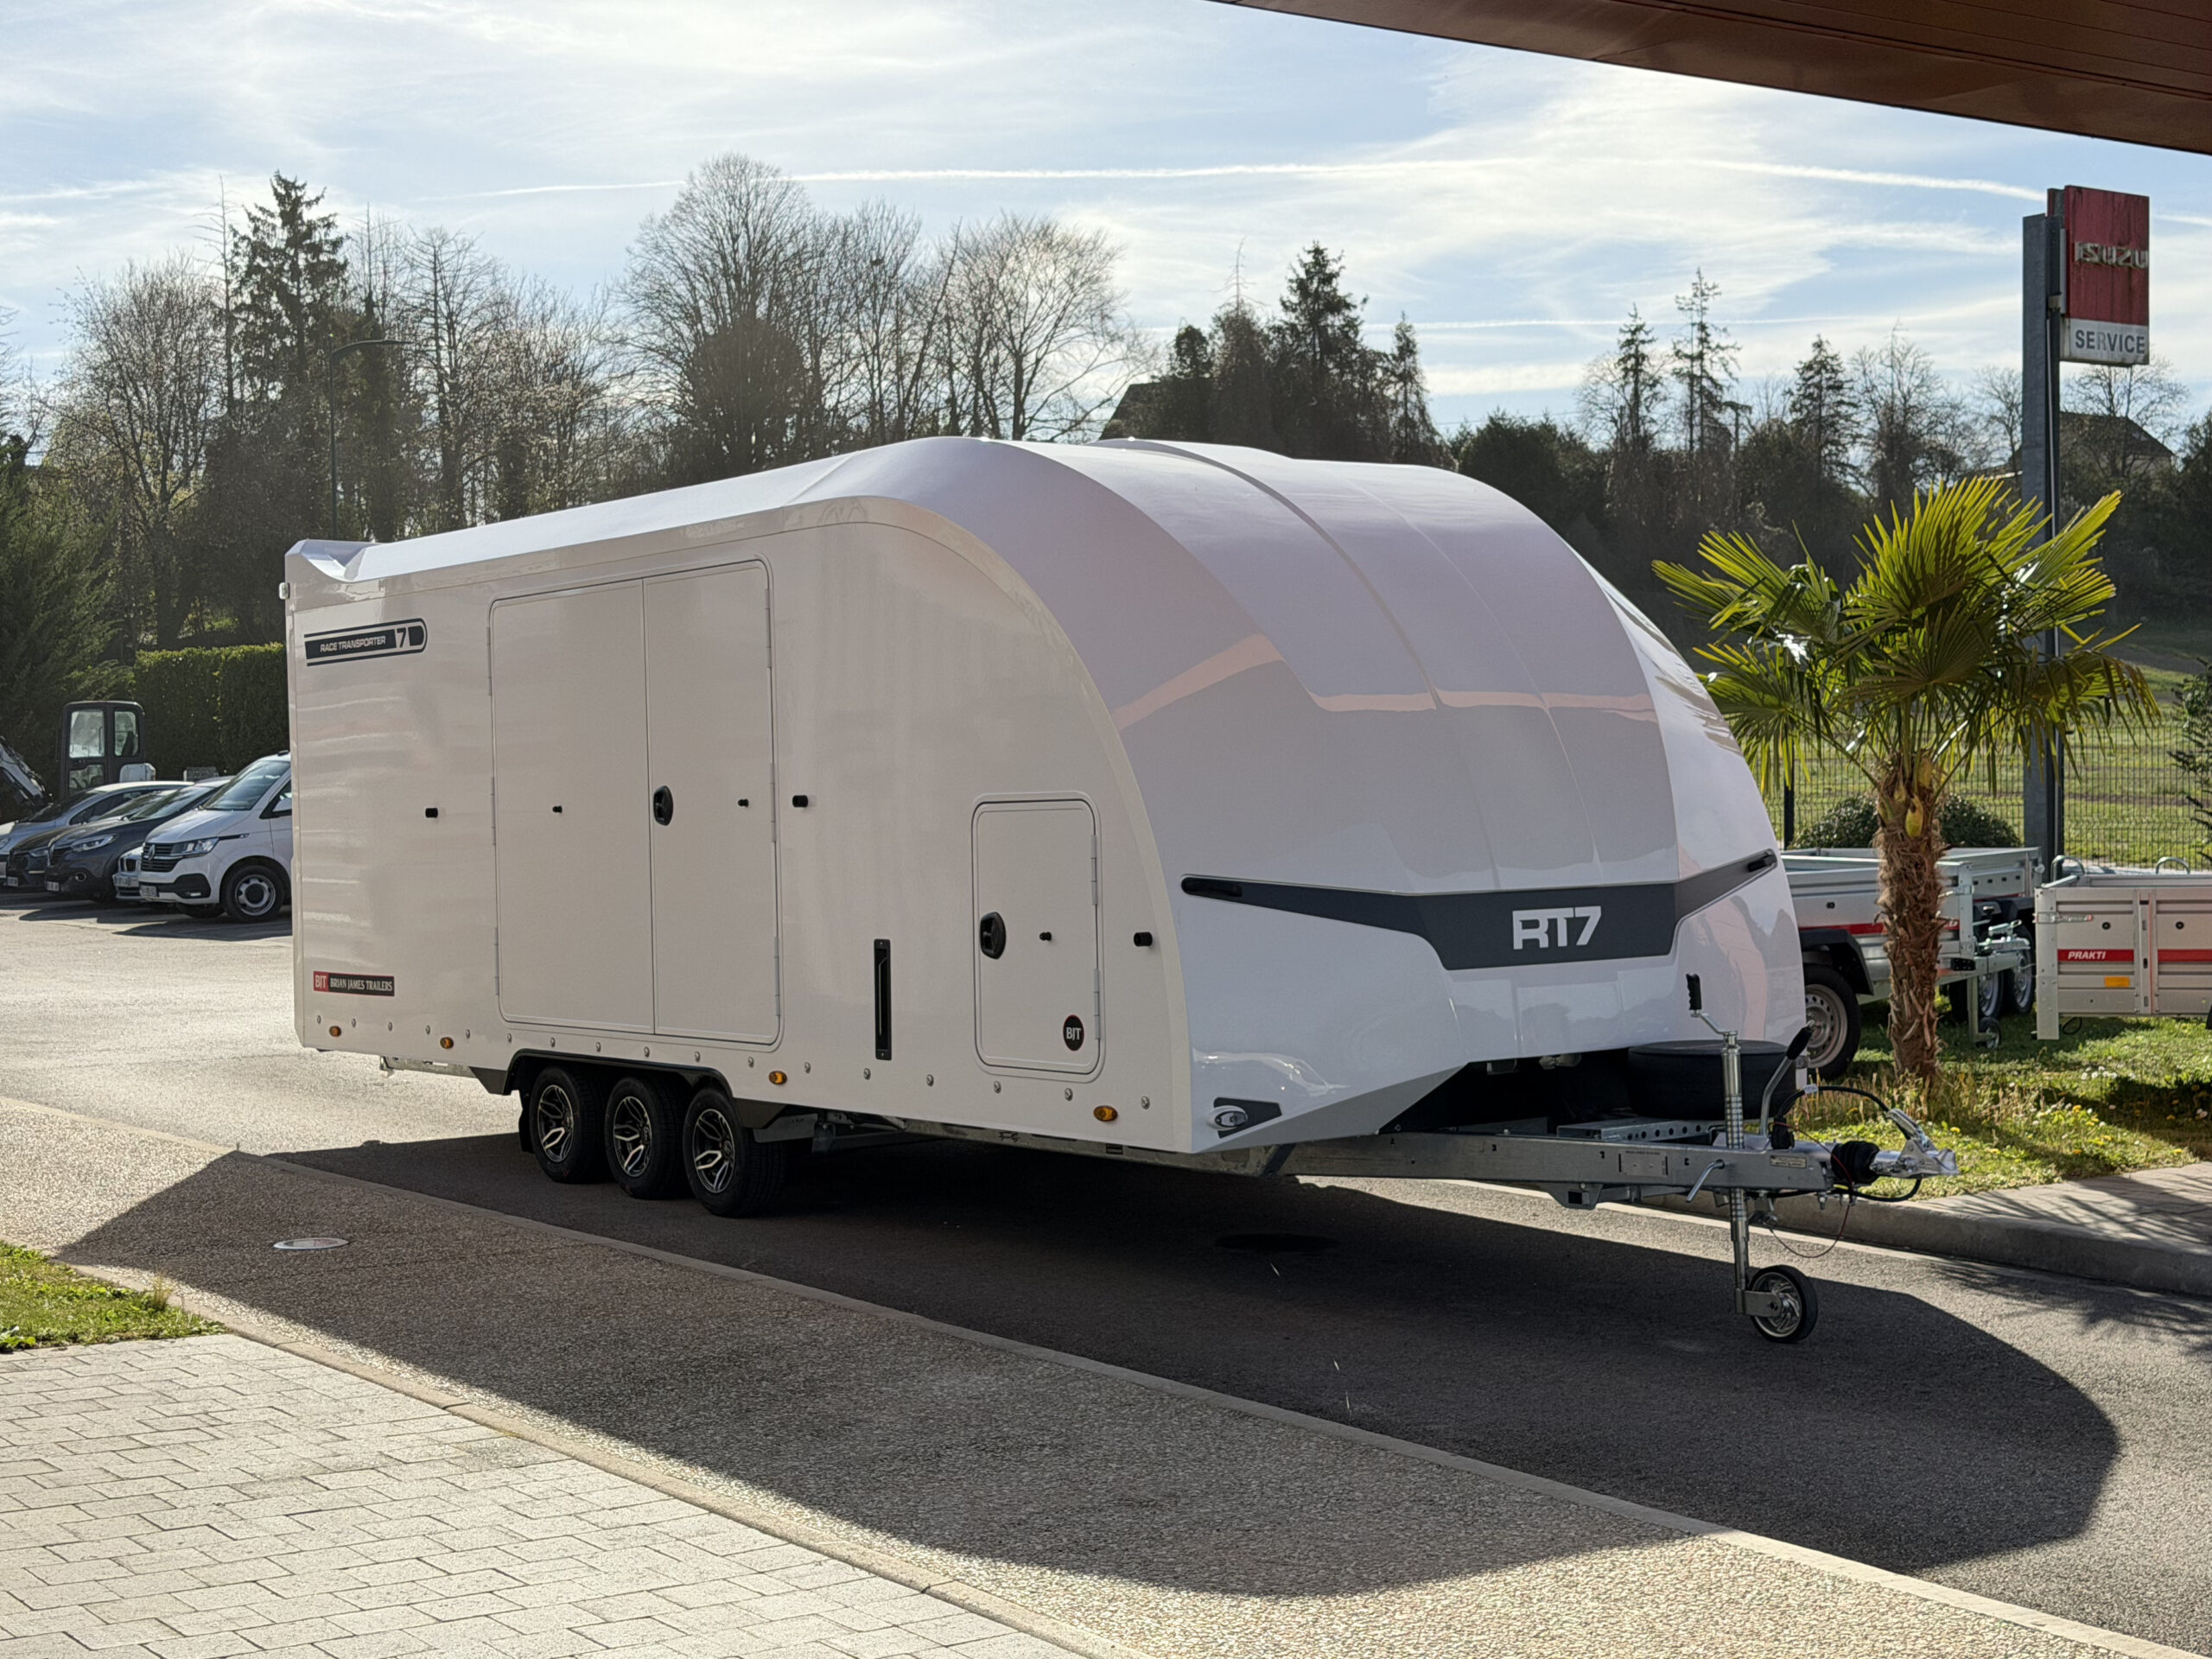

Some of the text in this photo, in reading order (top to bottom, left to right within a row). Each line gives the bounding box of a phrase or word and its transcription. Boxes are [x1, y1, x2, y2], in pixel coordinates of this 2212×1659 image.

[2075, 241, 2149, 269] ISUZU
[2075, 329, 2145, 353] SERVICE
[320, 627, 406, 652] RACE TRANSPORTER 7
[1512, 906, 1601, 950] RT7
[2068, 950, 2107, 960] PRAKTI
[315, 975, 327, 988] BJT
[330, 977, 393, 991] BRIAN JAMES TRAILERS
[1065, 1027, 1081, 1040] BJT
